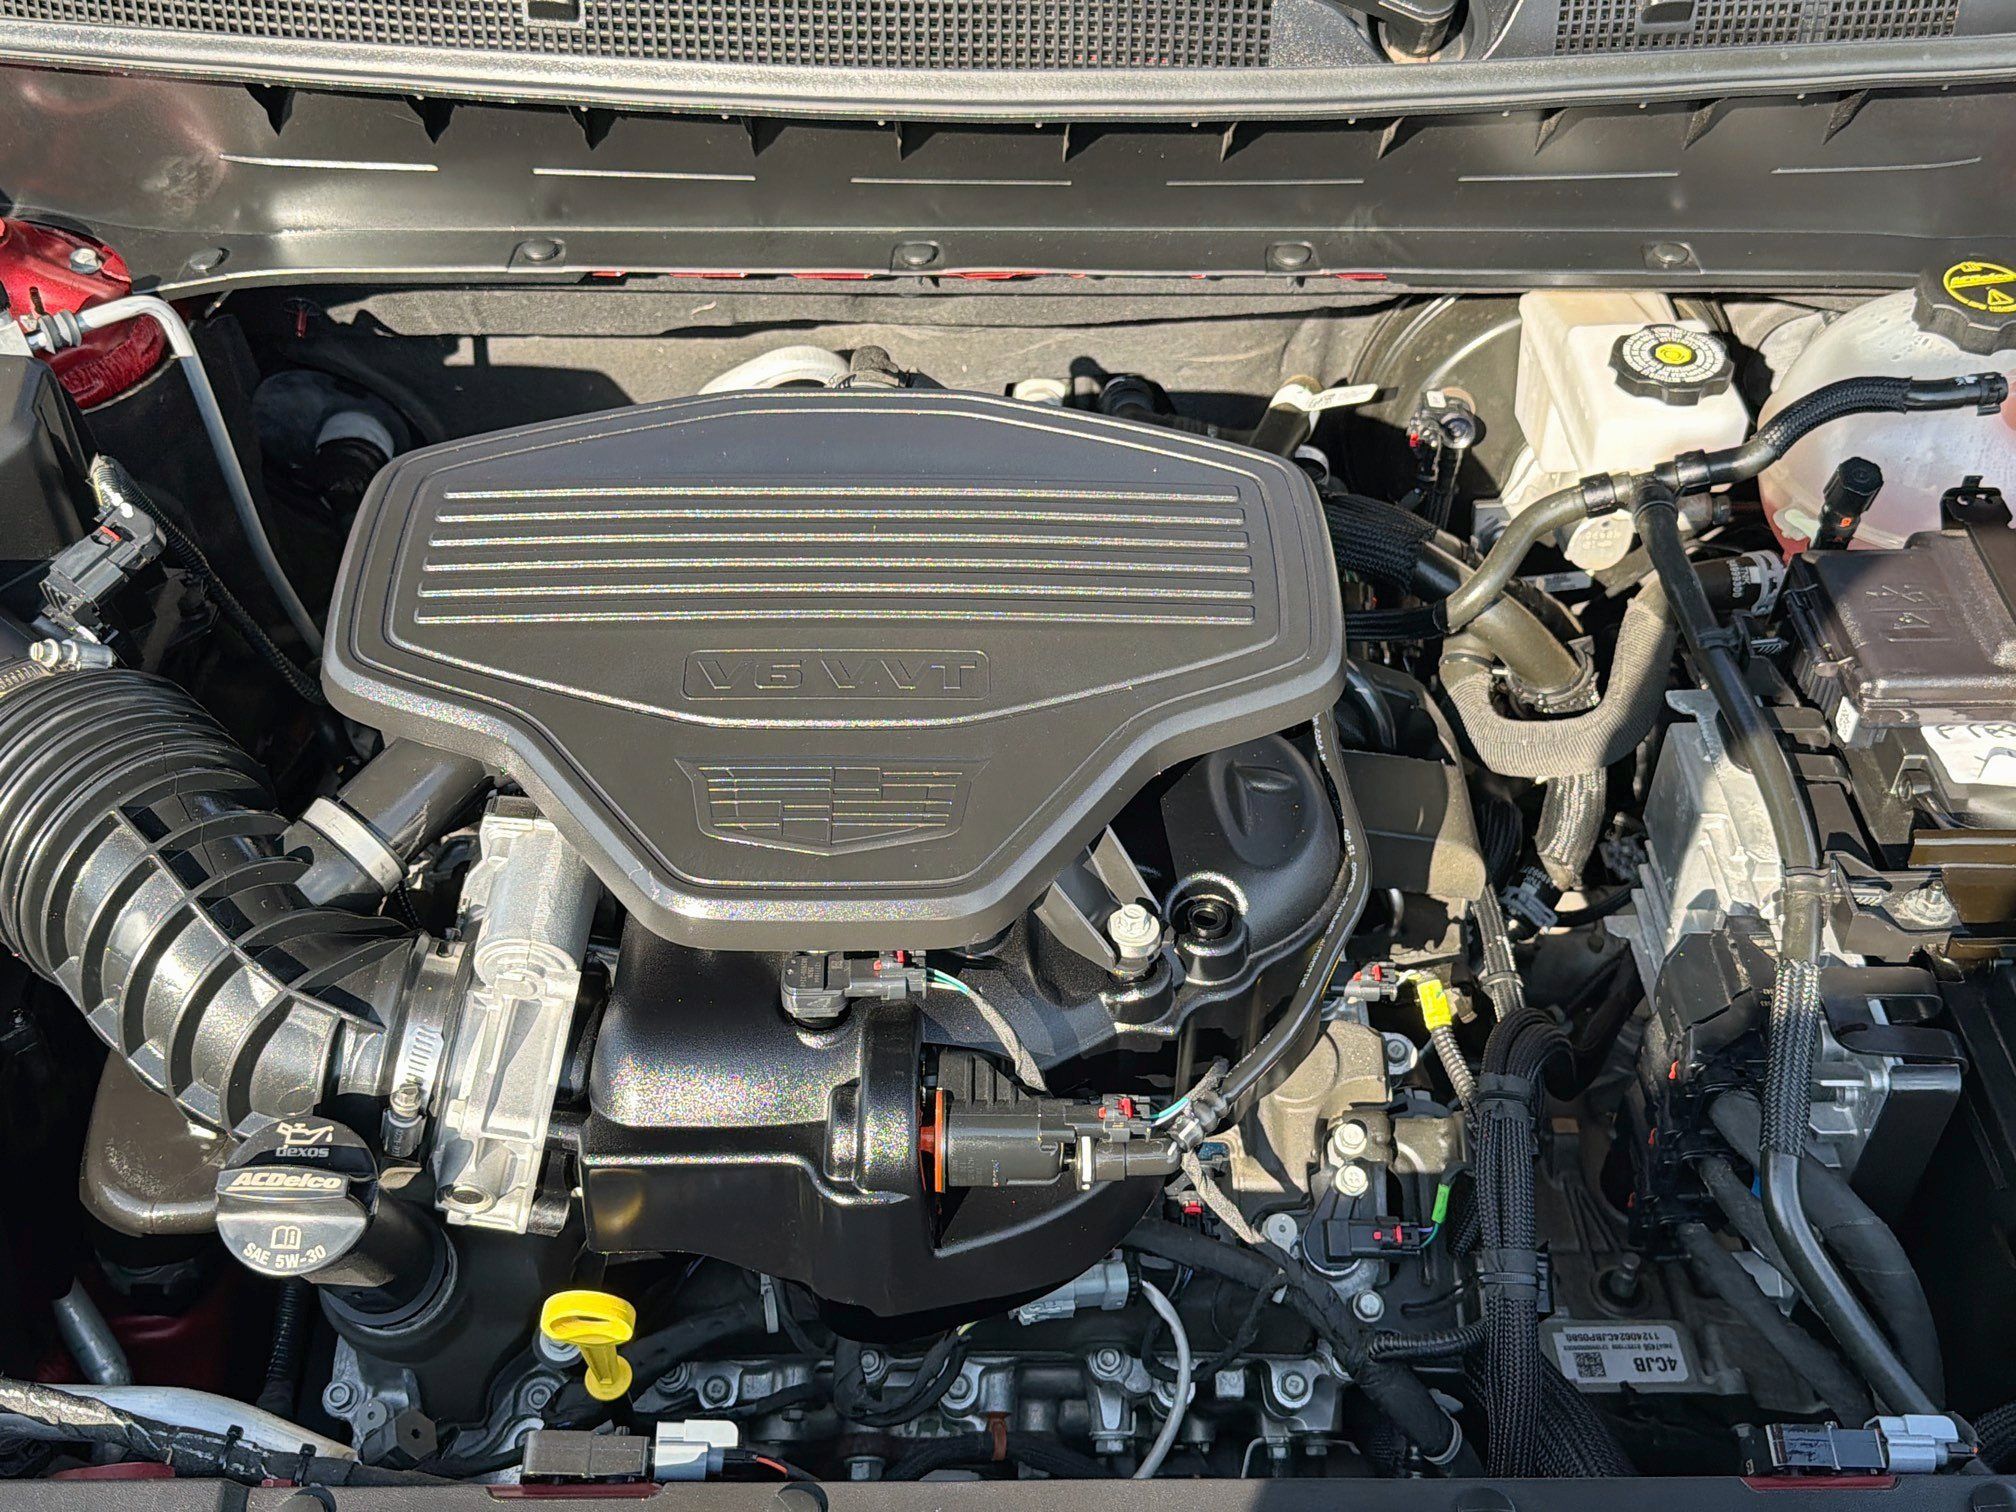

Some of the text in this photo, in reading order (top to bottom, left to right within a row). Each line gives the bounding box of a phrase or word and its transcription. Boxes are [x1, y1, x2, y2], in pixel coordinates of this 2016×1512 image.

[696, 658, 977, 690] V6 VVT
[275, 1144, 330, 1158] dexos
[228, 1172, 342, 1190] ACDelco
[243, 1242, 327, 1269] SAE 5W-30
[1632, 1356, 1678, 1373] 4CJB
